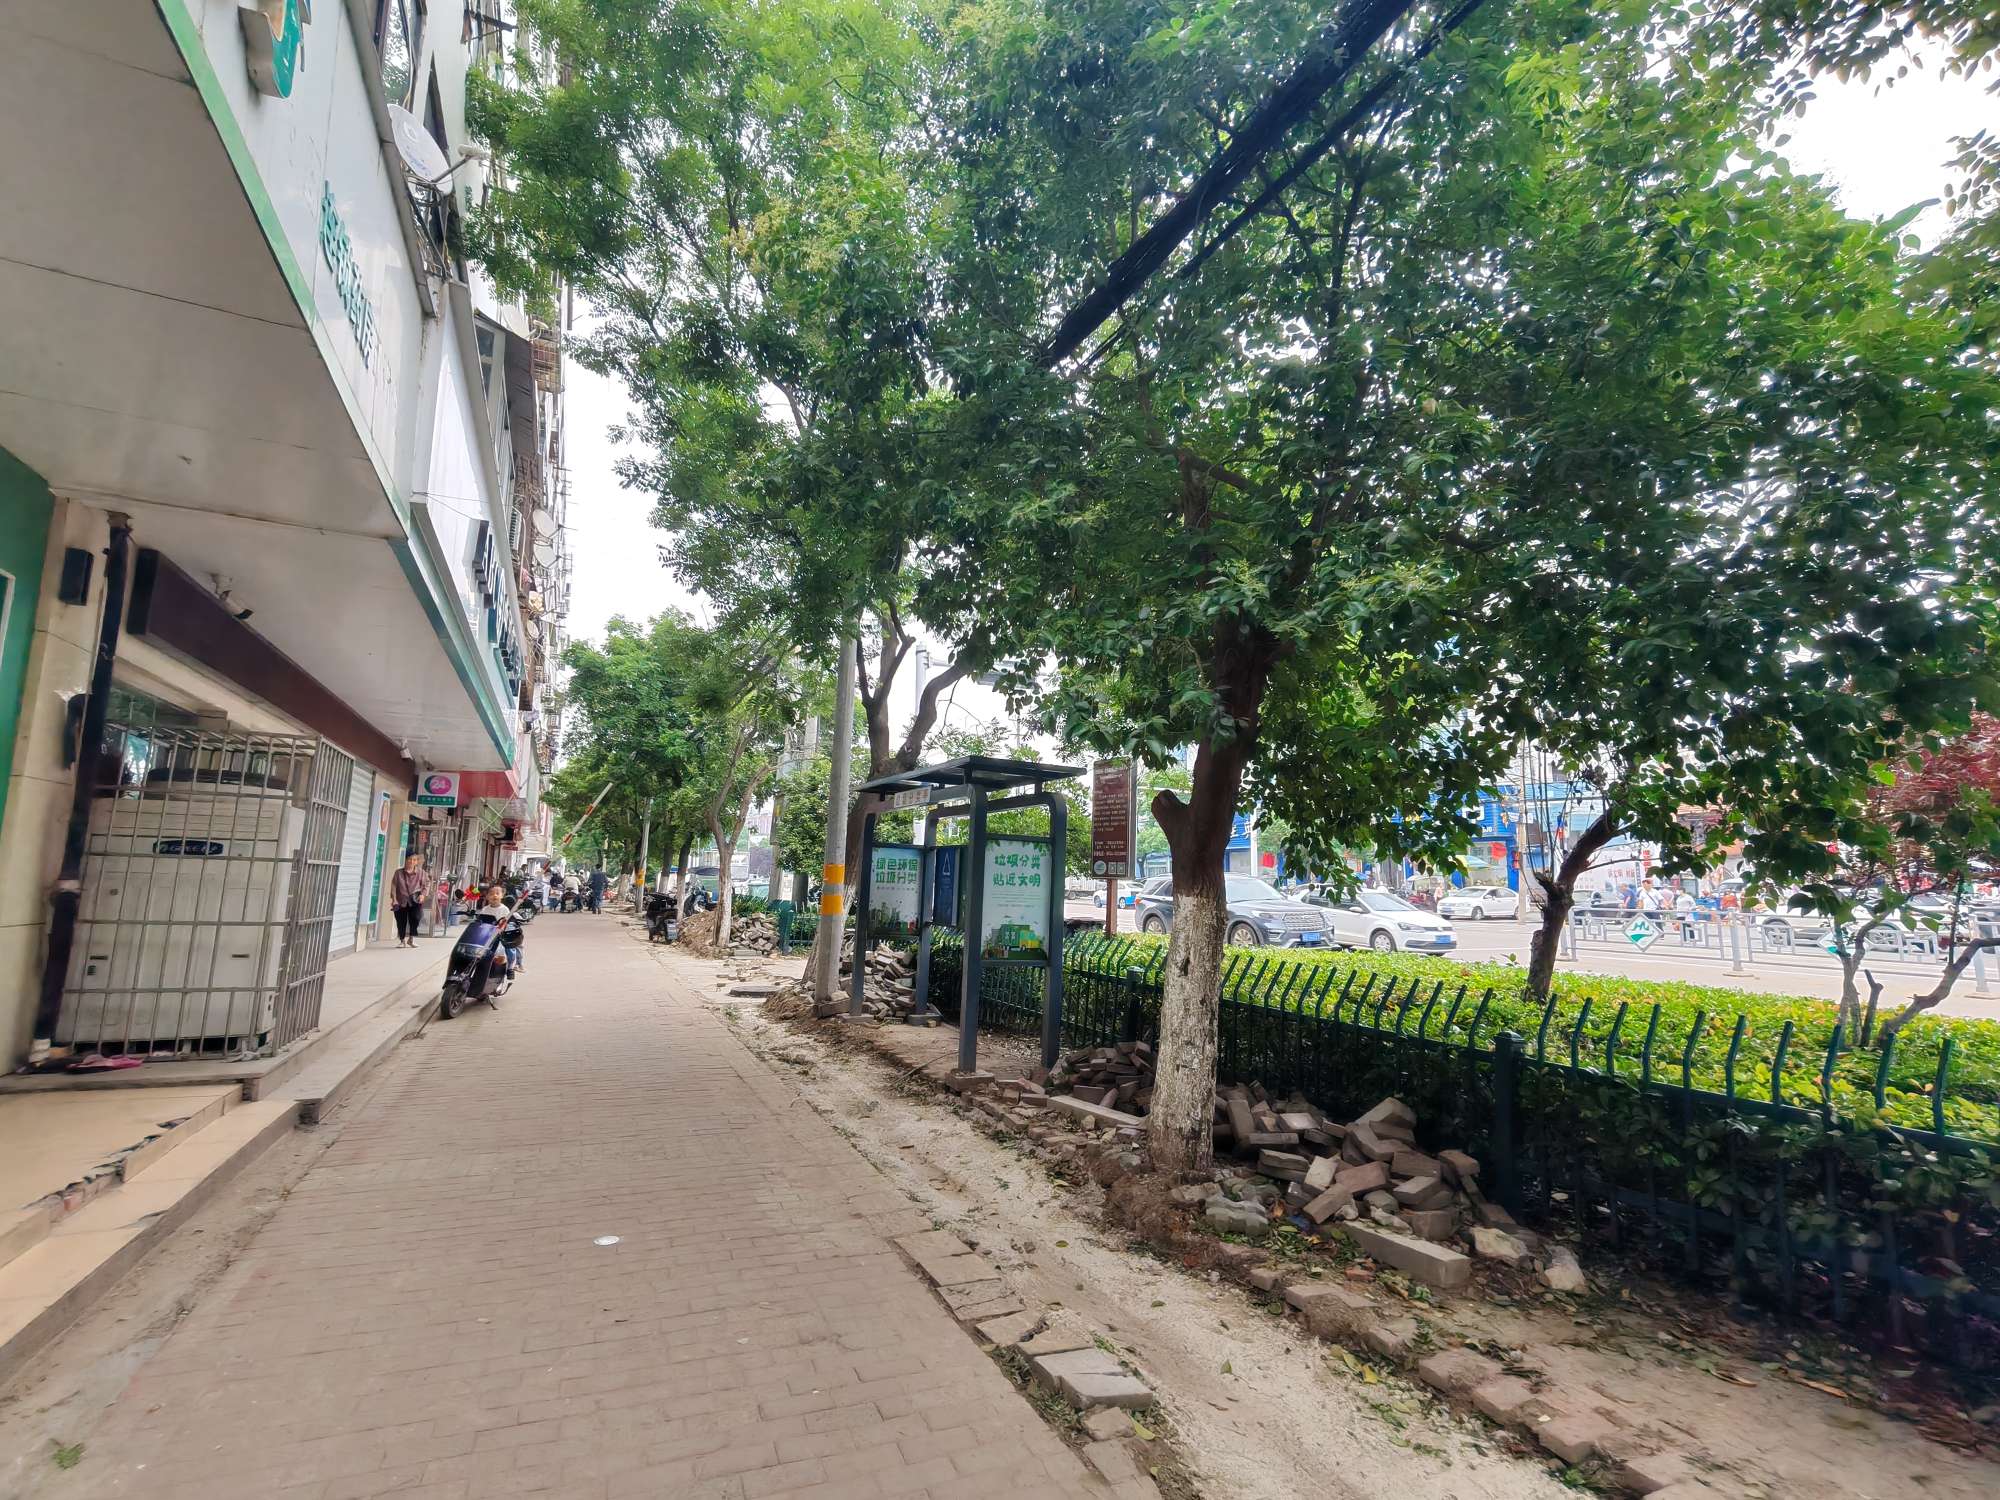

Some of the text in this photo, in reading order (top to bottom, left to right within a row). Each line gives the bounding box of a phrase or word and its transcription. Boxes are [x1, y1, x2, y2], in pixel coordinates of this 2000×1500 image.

[876, 857, 918, 871] 绿色环保
[994, 853, 1041, 870] 垃圾分类
[875, 871, 917, 885] 垃圾分类
[992, 872, 1041, 888] 贴近文明
